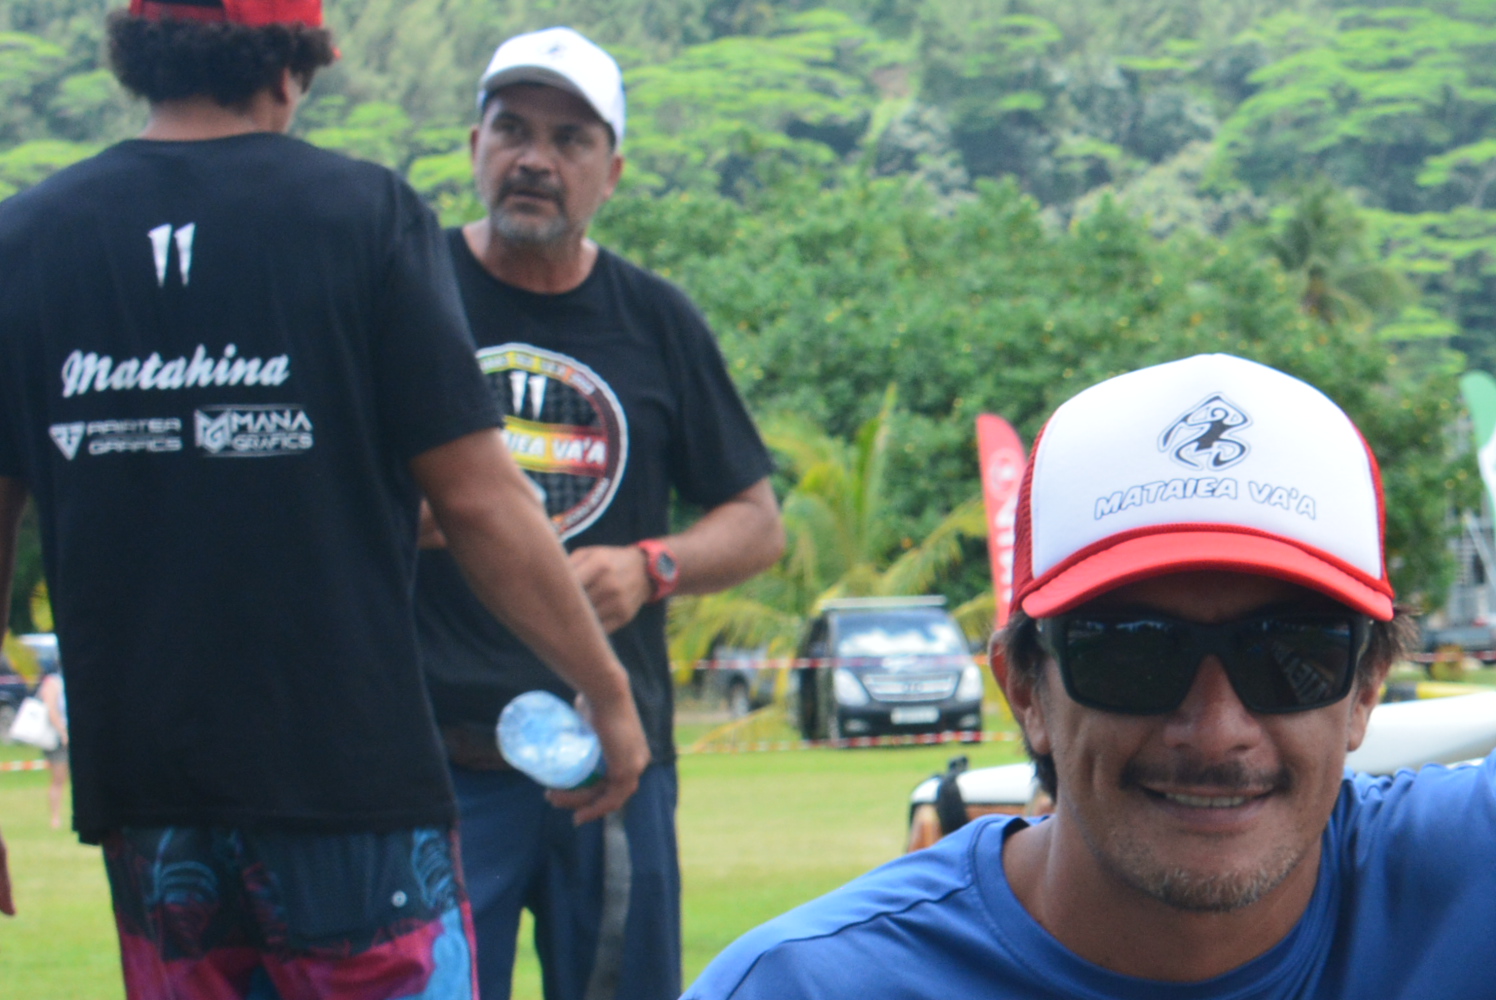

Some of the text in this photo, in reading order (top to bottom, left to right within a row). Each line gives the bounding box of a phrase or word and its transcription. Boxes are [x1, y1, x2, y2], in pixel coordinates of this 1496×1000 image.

[61, 343, 290, 399] Matahina
[232, 408, 312, 433] MANA
[232, 432, 313, 451] GRAFICS
[1094, 476, 1316, 521] MATAIEA VA'A
